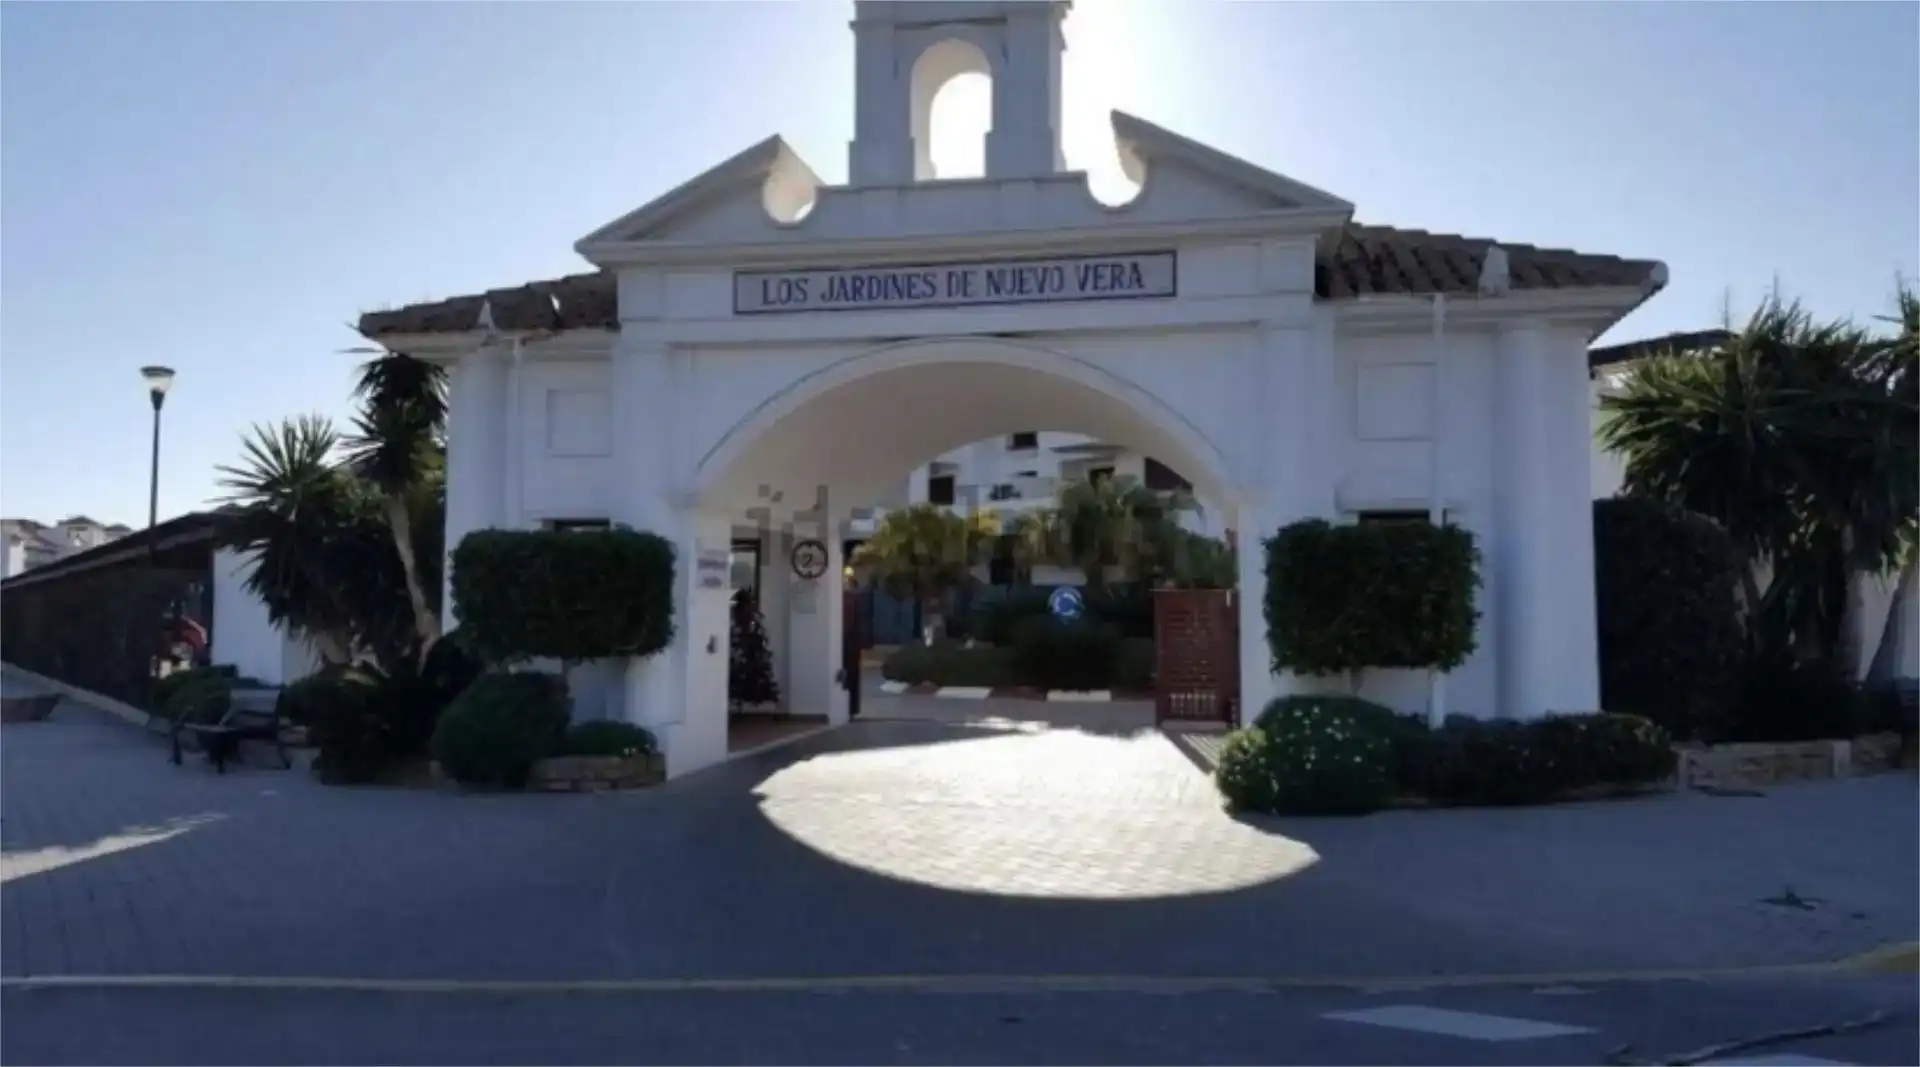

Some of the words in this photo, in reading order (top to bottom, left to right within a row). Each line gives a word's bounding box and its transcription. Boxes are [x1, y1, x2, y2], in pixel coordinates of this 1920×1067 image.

[762, 278, 808, 305] LOS
[820, 273, 937, 303] JARDINES
[946, 270, 977, 298] DE
[986, 265, 1065, 297] NUEVO
[1075, 261, 1145, 292] VERA
